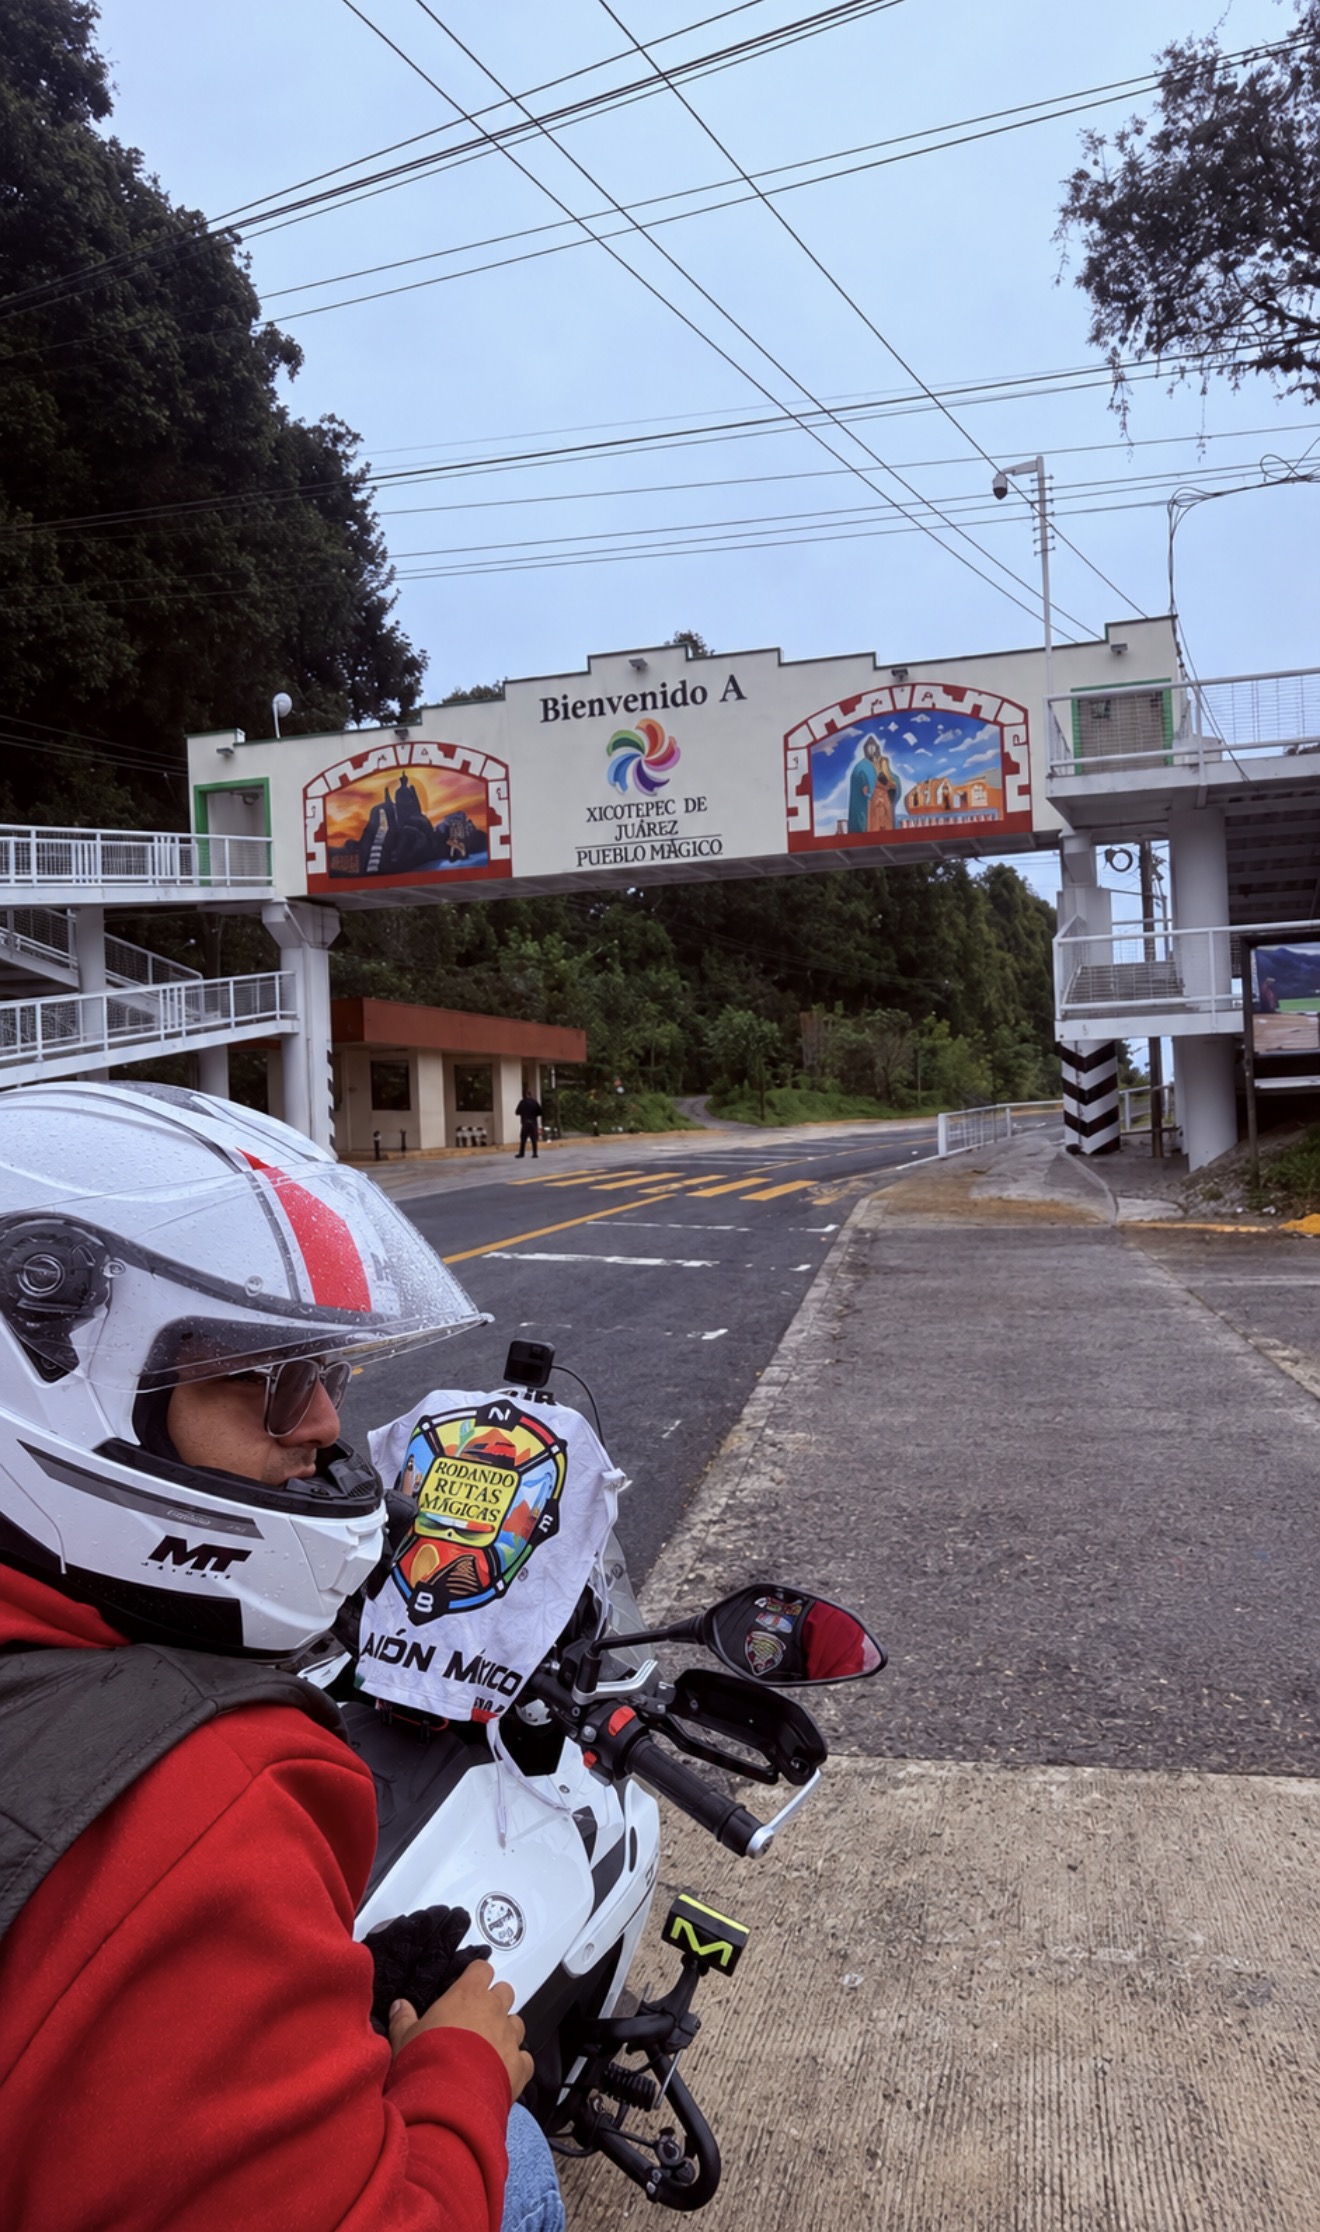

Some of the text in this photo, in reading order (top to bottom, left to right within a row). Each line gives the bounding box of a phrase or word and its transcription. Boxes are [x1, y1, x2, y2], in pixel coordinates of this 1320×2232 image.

[539, 674, 748, 723] Bienvenido A
[585, 796, 708, 823] XICOTEPEC DE
[614, 819, 679, 842] JUÁREZ
[576, 844, 647, 868] PUEBLO
[434, 1461, 515, 1488] RODANDO
[433, 1477, 503, 1506] RUTAS
[147, 1534, 253, 1573] MT
